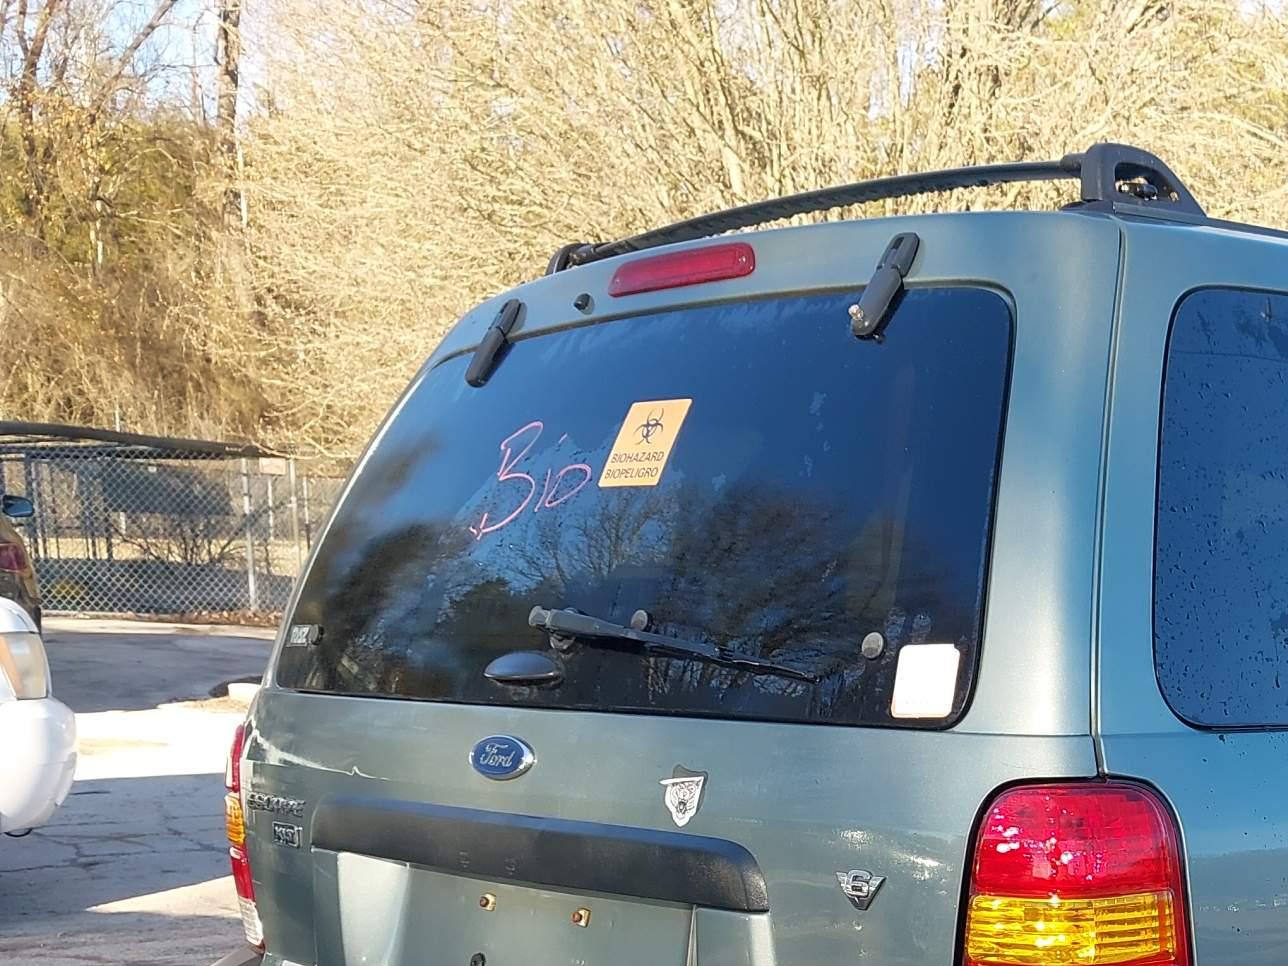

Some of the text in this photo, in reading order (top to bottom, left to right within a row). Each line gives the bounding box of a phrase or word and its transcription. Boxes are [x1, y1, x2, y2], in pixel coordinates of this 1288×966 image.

[611, 451, 665, 463] BIOHAZARD
[605, 467, 659, 479] BIOPELIGRO
[480, 742, 516, 767] Ford
